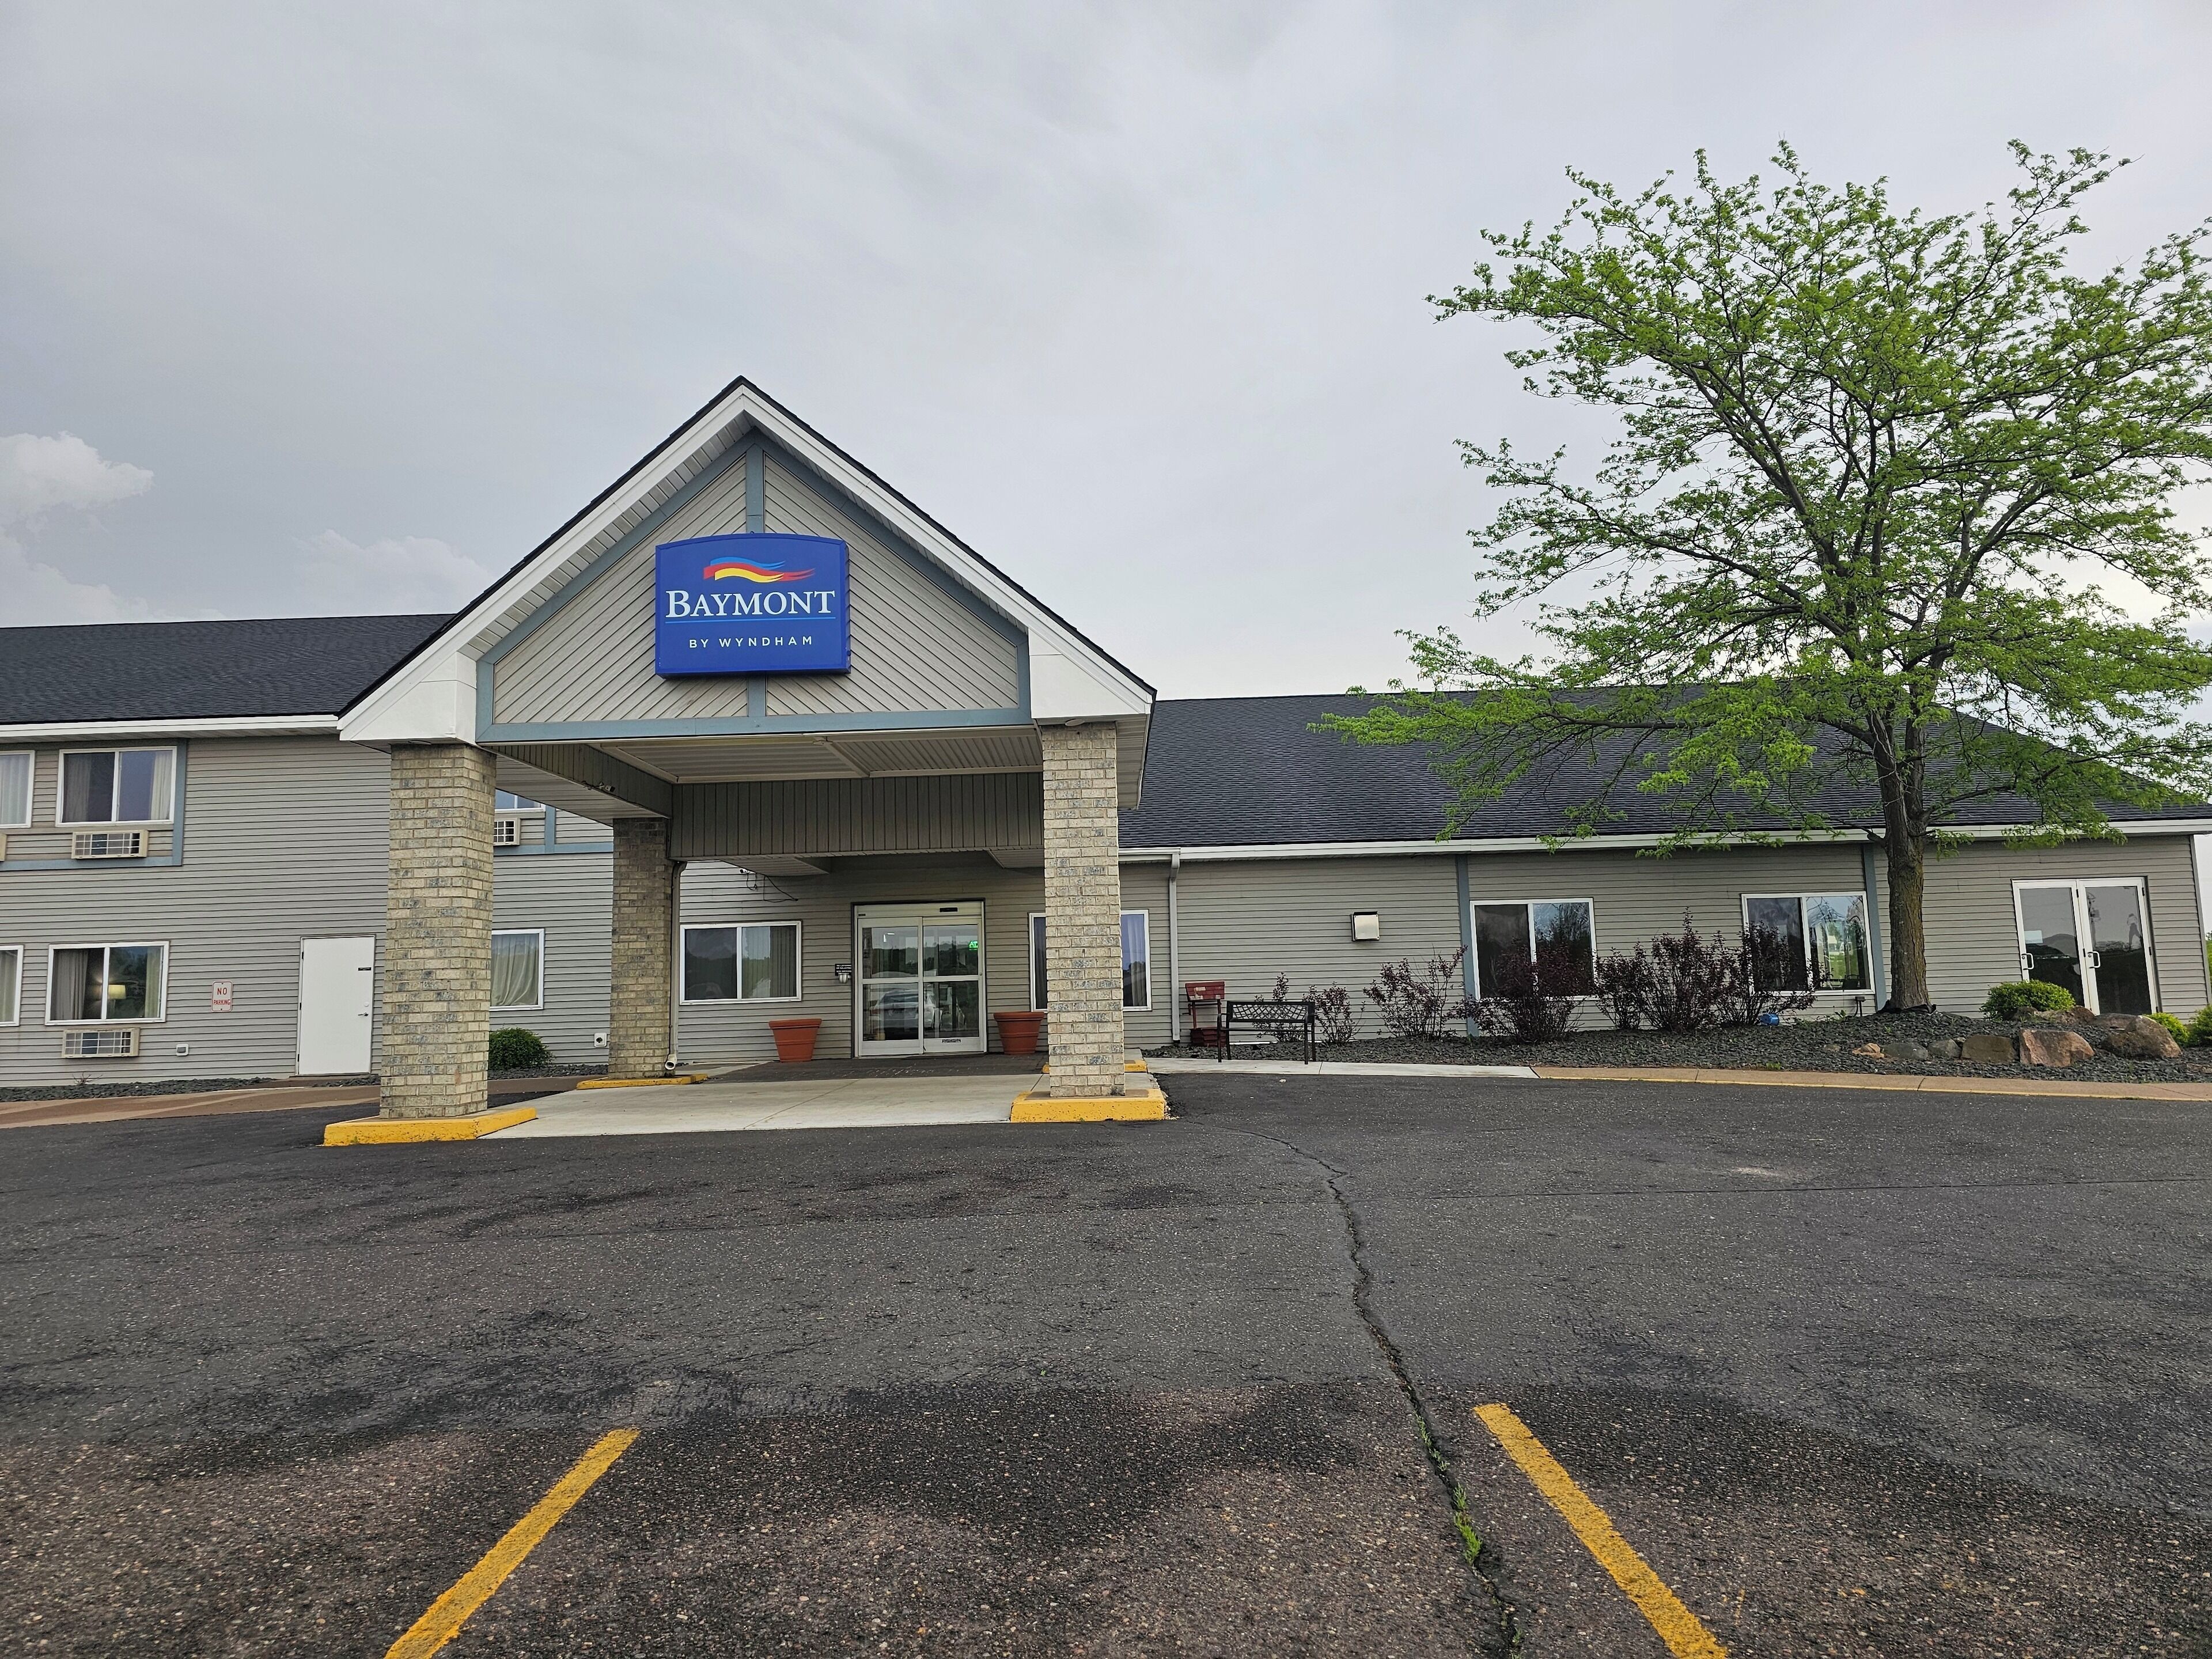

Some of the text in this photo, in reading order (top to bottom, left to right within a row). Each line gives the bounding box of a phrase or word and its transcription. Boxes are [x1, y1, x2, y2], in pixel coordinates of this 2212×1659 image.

[665, 590, 835, 618] BAYMONT
[689, 636, 812, 649] BY WYNDHAM
[217, 987, 228, 995] NO
